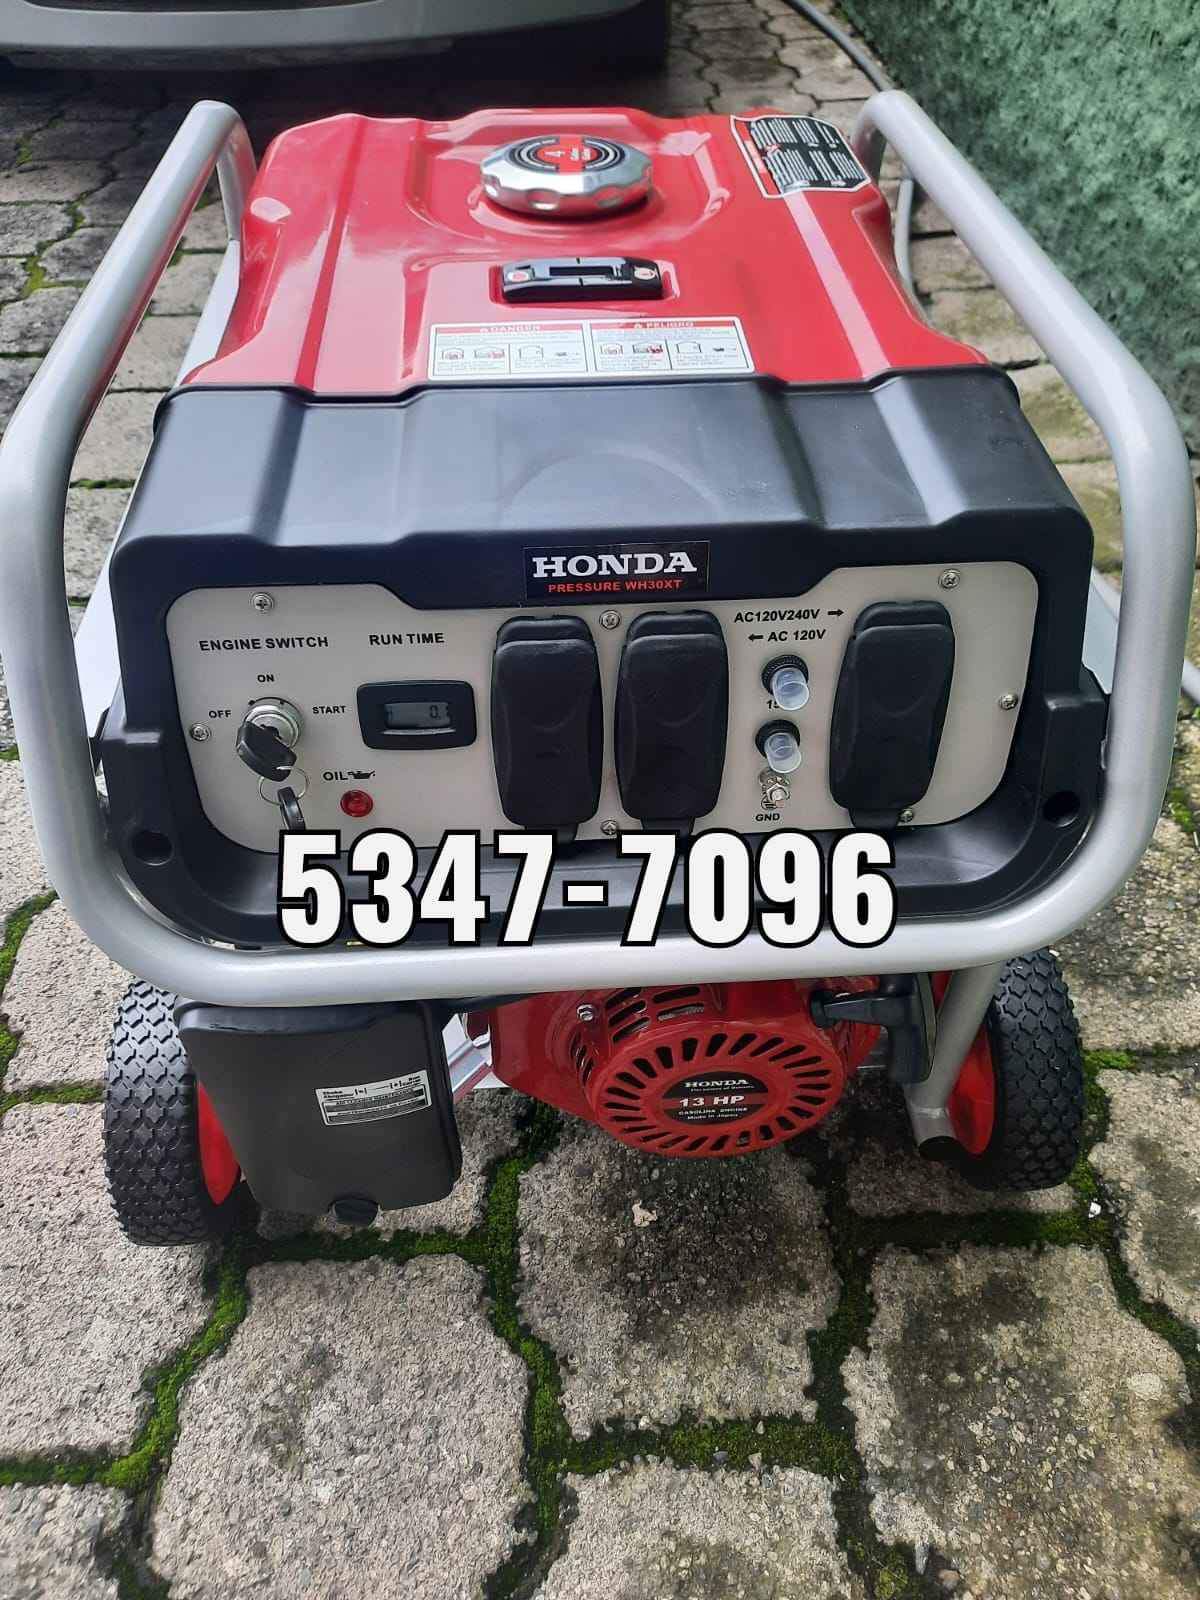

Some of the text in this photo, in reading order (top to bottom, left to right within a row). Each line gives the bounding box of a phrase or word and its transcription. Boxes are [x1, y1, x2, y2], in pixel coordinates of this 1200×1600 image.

[532, 552, 698, 578] HONDA
[548, 579, 683, 593] PRESSURE WH30XT
[734, 609, 821, 623] AC120V240V
[369, 632, 445, 646] RUN TIME
[768, 629, 826, 642] AC 120V
[199, 636, 329, 652] ENGINE SWITCH
[257, 673, 275, 683] ON
[208, 709, 232, 719] OFF
[312, 705, 347, 715] START
[323, 771, 348, 781] OIL
[755, 813, 781, 822] GND
[685, 1079, 749, 1087] HONDA
[680, 1095, 745, 1107] 13 HP
